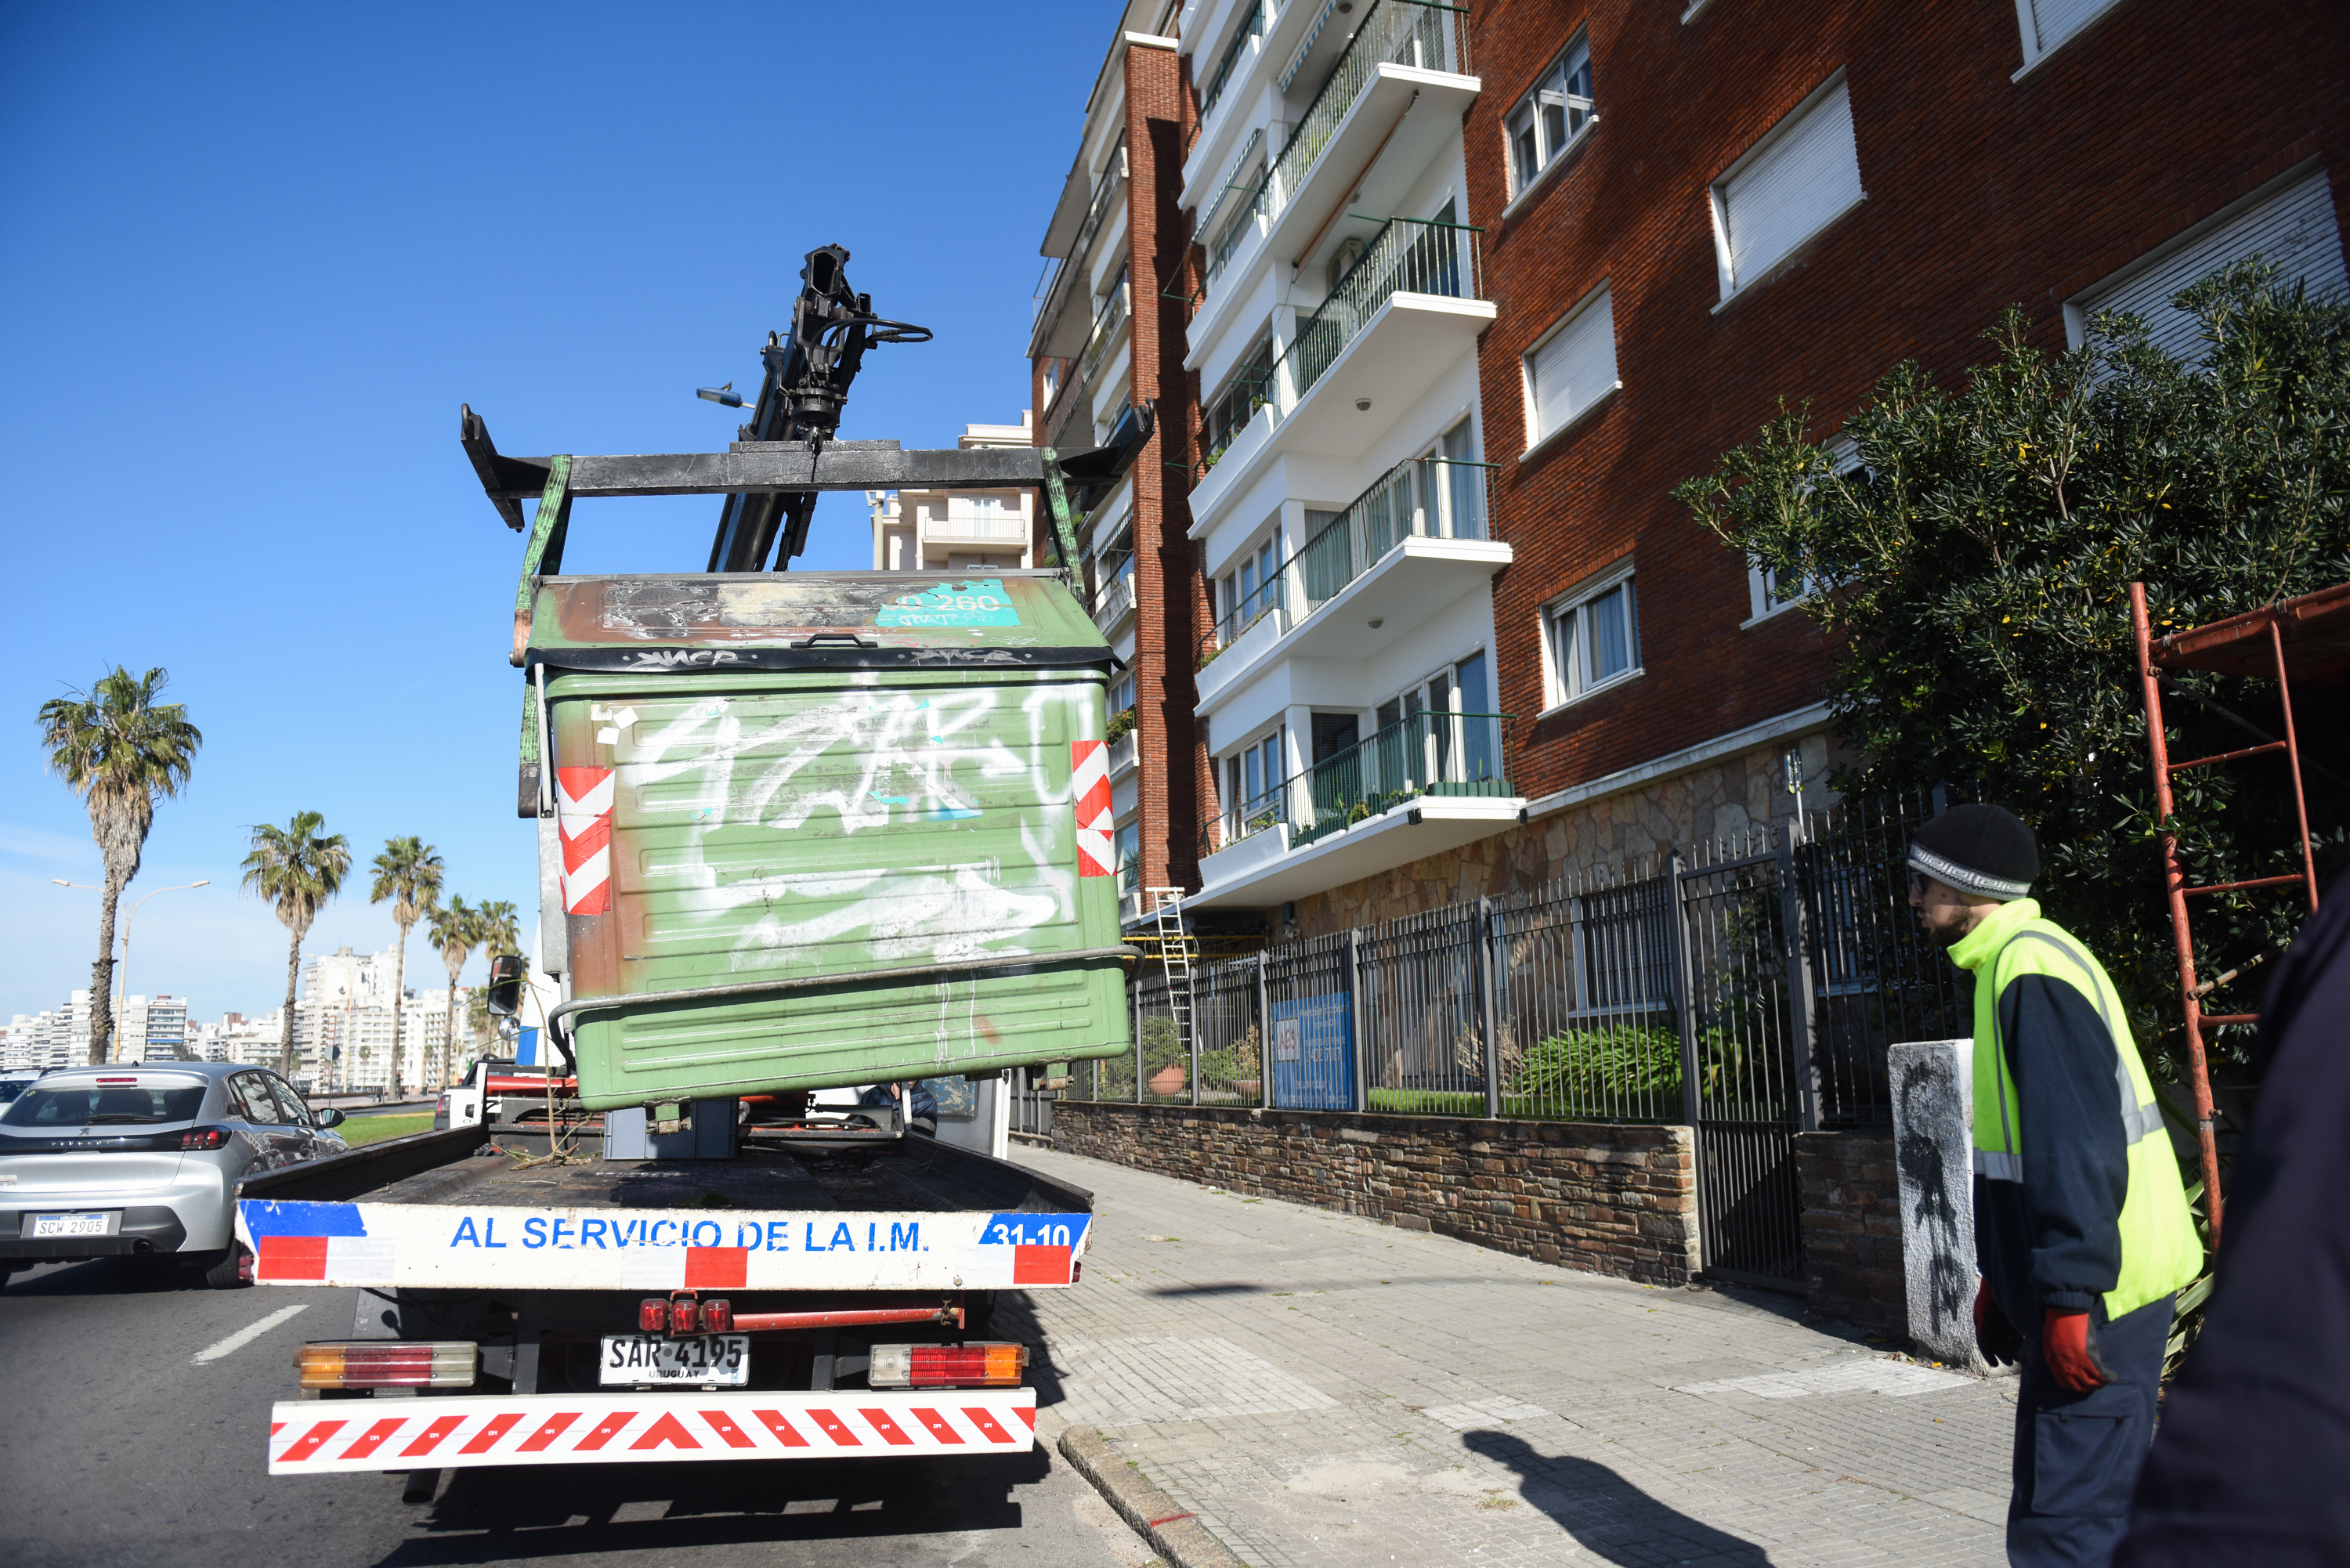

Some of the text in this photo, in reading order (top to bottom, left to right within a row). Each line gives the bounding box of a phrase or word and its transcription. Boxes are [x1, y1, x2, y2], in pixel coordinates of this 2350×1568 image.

[935, 595, 1000, 611] 260
[70, 1220, 103, 1234] 2905
[450, 1216, 929, 1252] AL SERVICIO DE LA I.M.
[992, 1223, 1071, 1246] 31-10
[649, 1370, 700, 1379] URUGUAY
